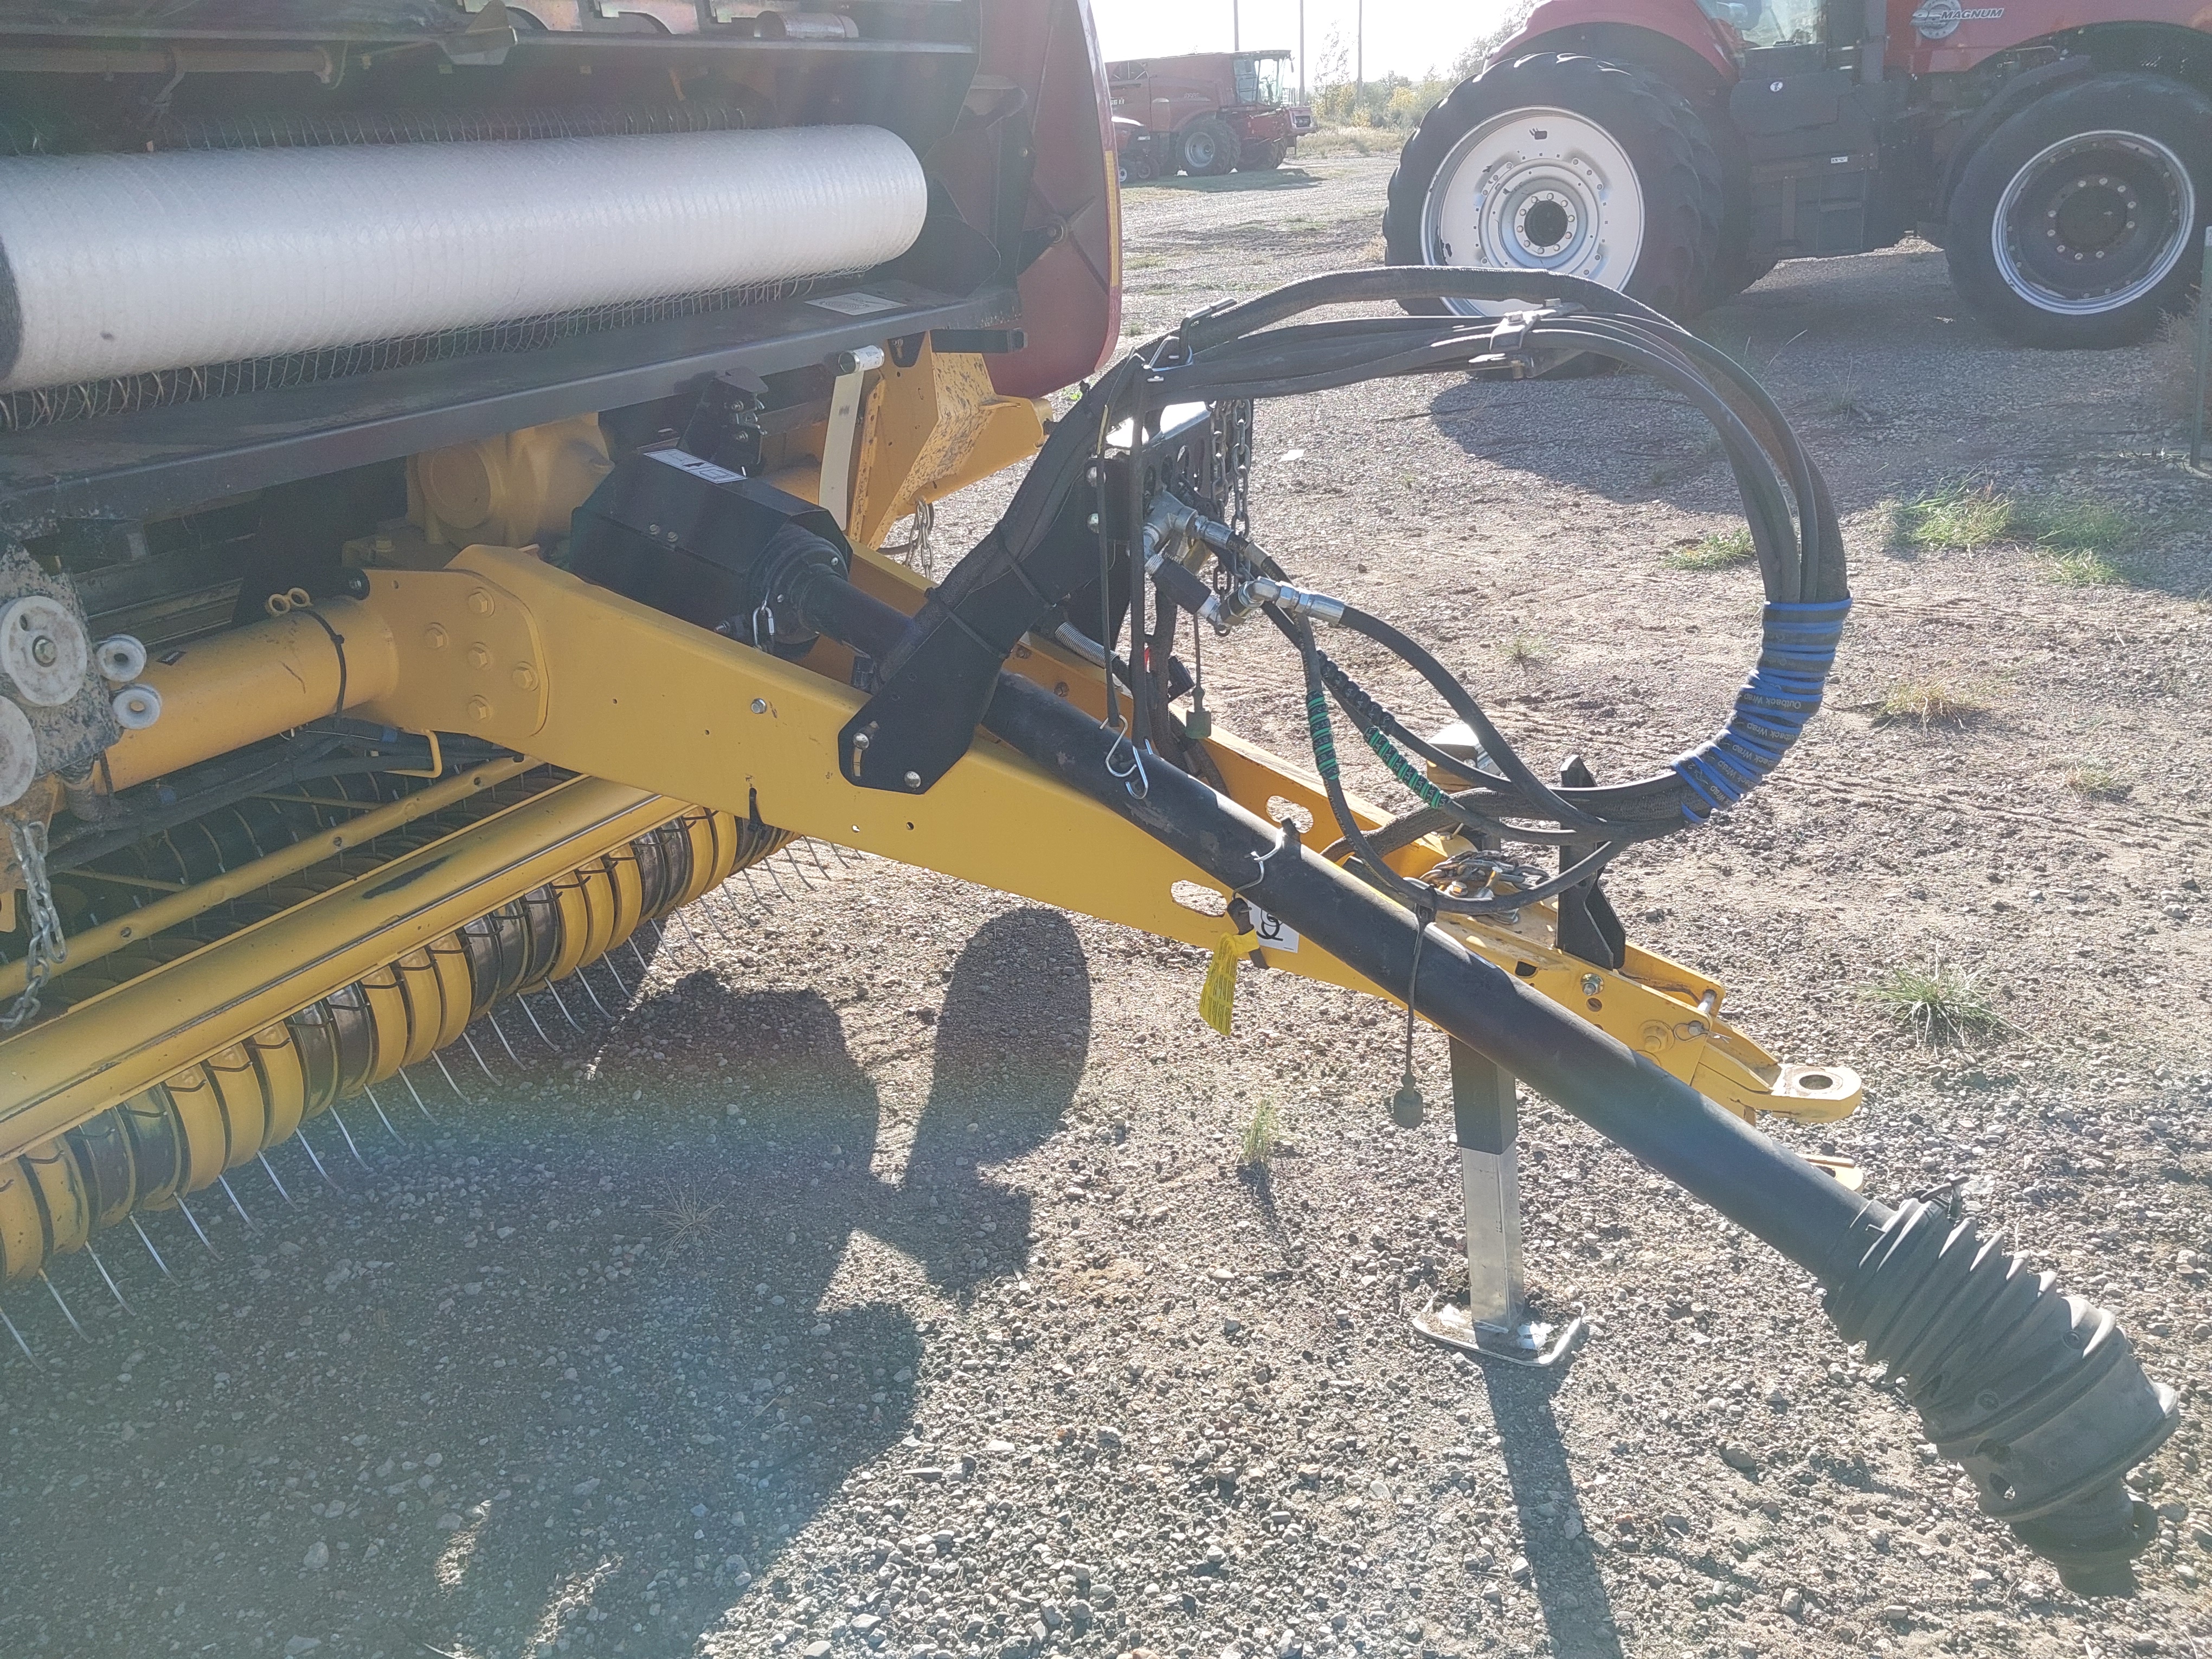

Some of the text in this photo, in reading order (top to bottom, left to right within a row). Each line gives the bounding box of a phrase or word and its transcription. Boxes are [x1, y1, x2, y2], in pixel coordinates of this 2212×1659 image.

[1940, 8, 2004, 20] MAGNUM
[1744, 694, 1802, 709] Outback Wrap
[1747, 722, 1799, 741] utback Wrap
[1732, 744, 1753, 760] Wrap
[1718, 760, 1737, 779] Wrap
[1710, 786, 1726, 802] Wrap
